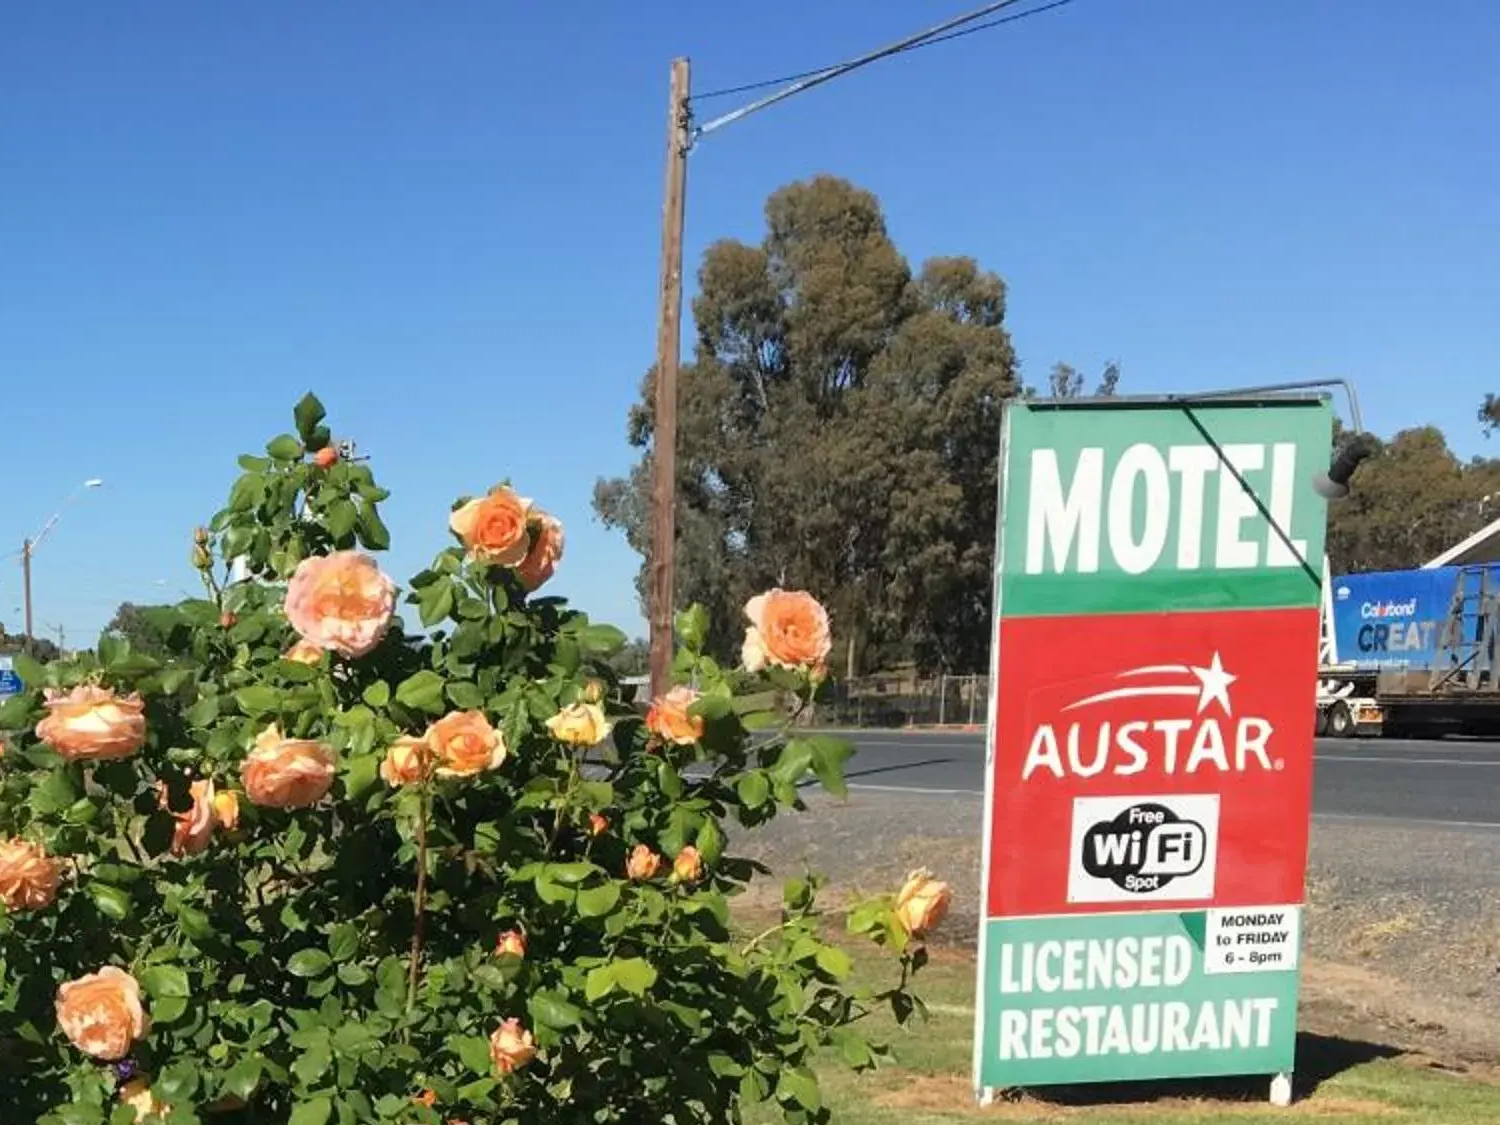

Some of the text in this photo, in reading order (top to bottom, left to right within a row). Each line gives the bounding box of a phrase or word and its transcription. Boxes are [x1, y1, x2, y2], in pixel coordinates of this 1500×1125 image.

[1025, 443, 1308, 575] MOTEL
[1129, 807, 1165, 824] Free
[1125, 874, 1160, 893] Spot
[1221, 913, 1285, 928] MONDAY
[1216, 930, 1290, 946] to FRIDAY
[1000, 935, 1193, 994] LICENSED
[1225, 951, 1235, 965] 6
[1249, 951, 1283, 966] 8pm
[999, 998, 1279, 1061] RESTAURANT
